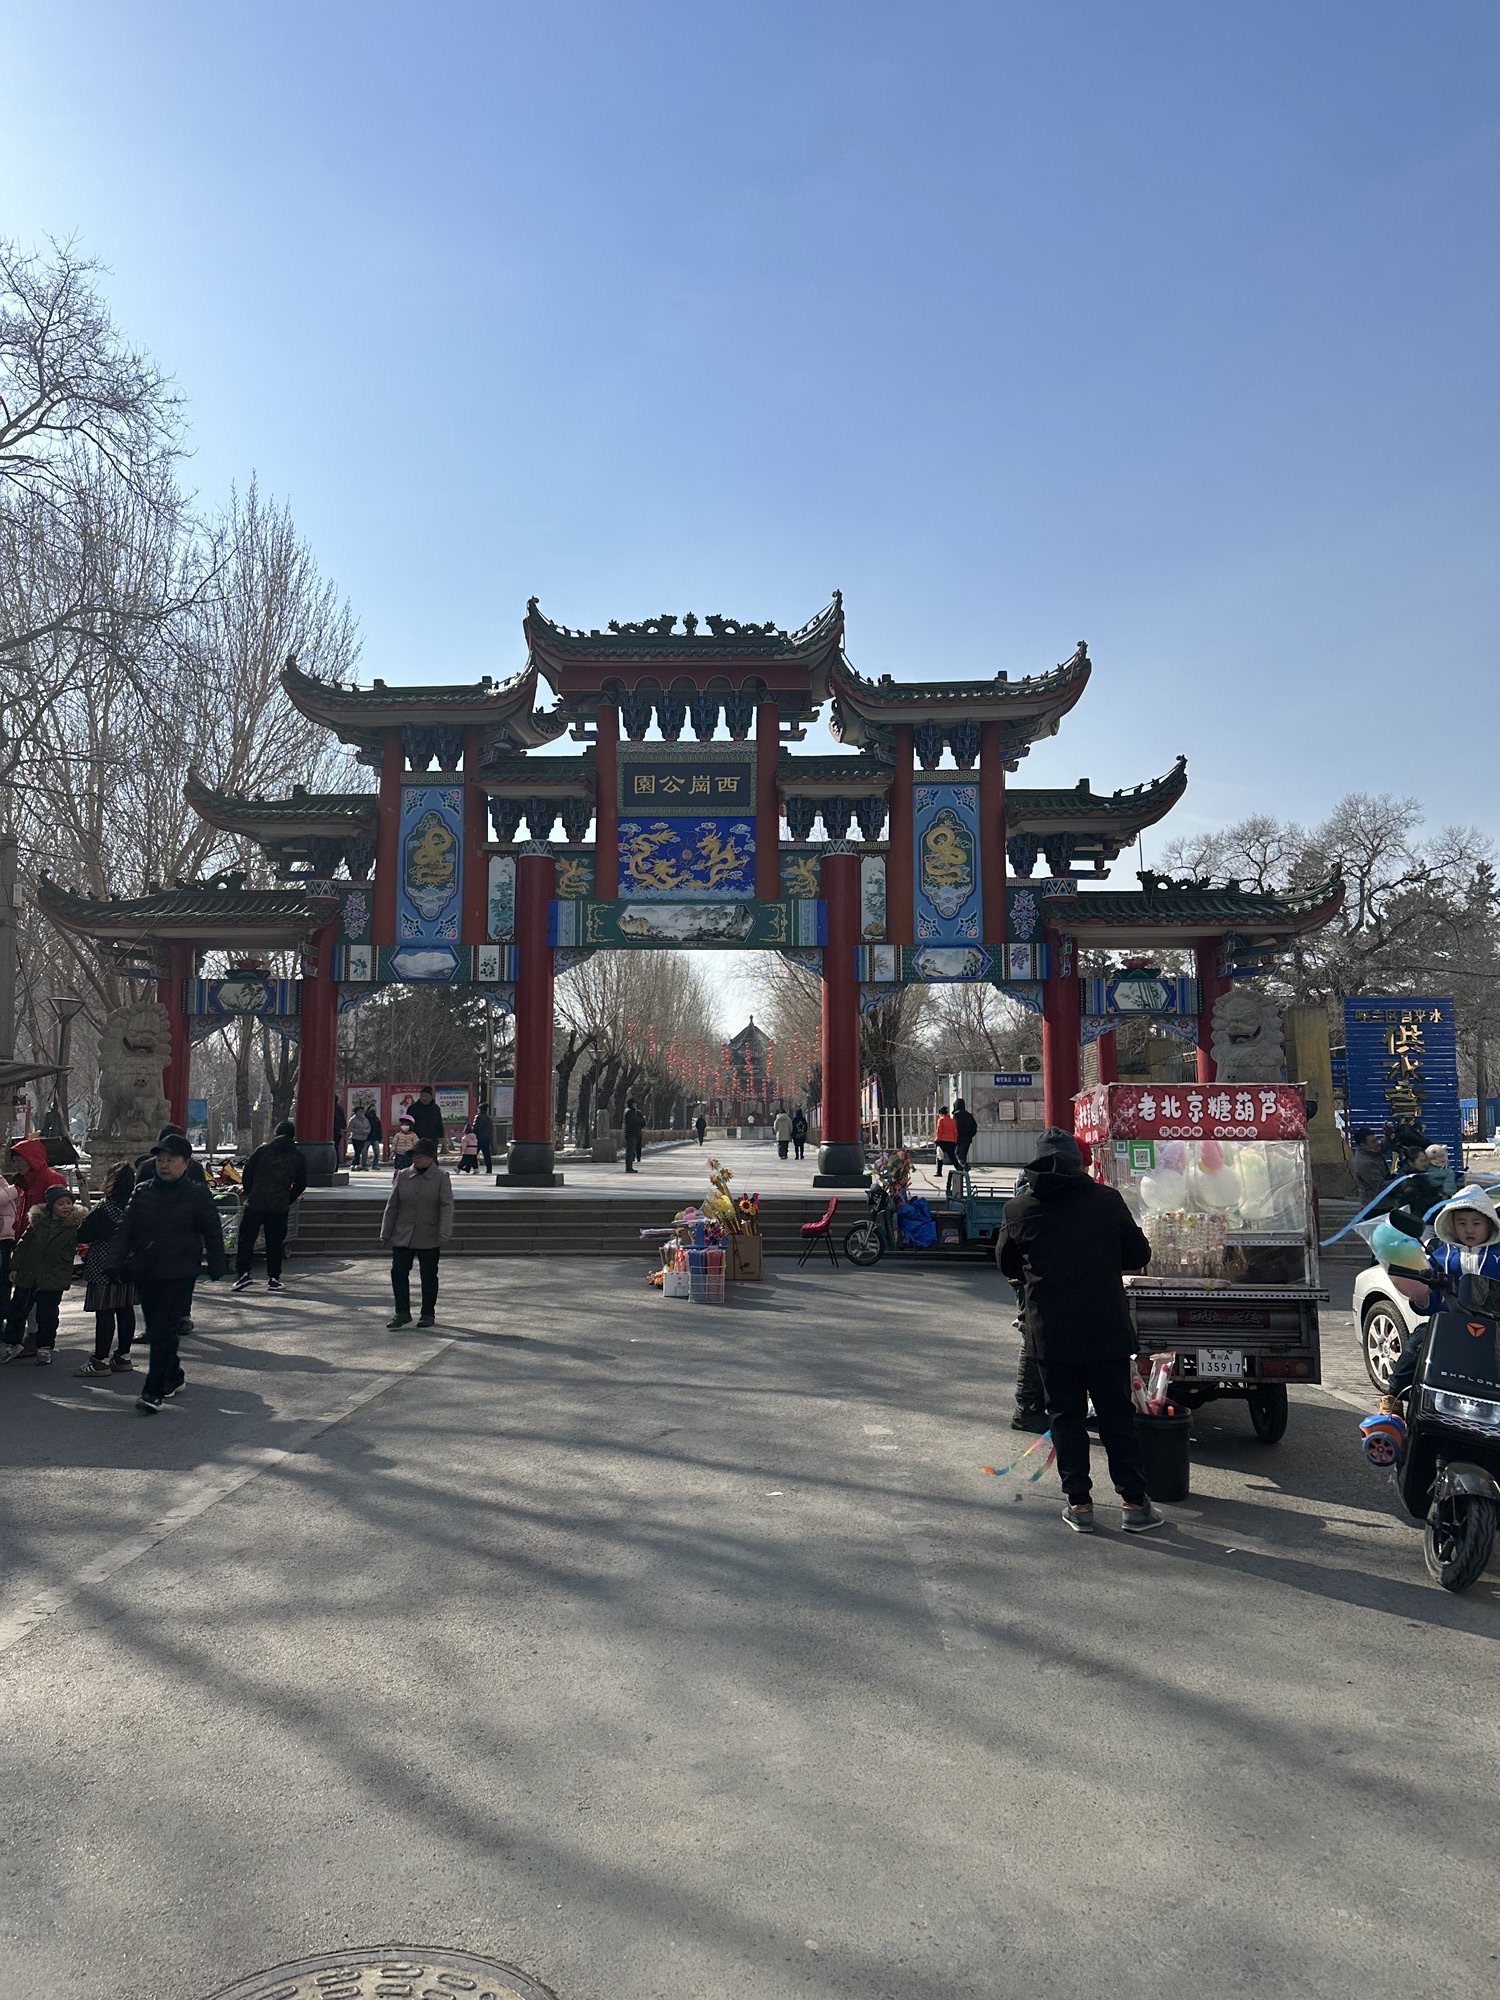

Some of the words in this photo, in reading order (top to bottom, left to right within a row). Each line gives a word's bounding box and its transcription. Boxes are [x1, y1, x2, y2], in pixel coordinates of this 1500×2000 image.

[1137, 1090, 1278, 1123] 老北京糖葫芦
[1159, 1126, 1203, 1137] 开胃提神
[1214, 1126, 1258, 1138] 有益身心
[1201, 1362, 1241, 1373] 135917
